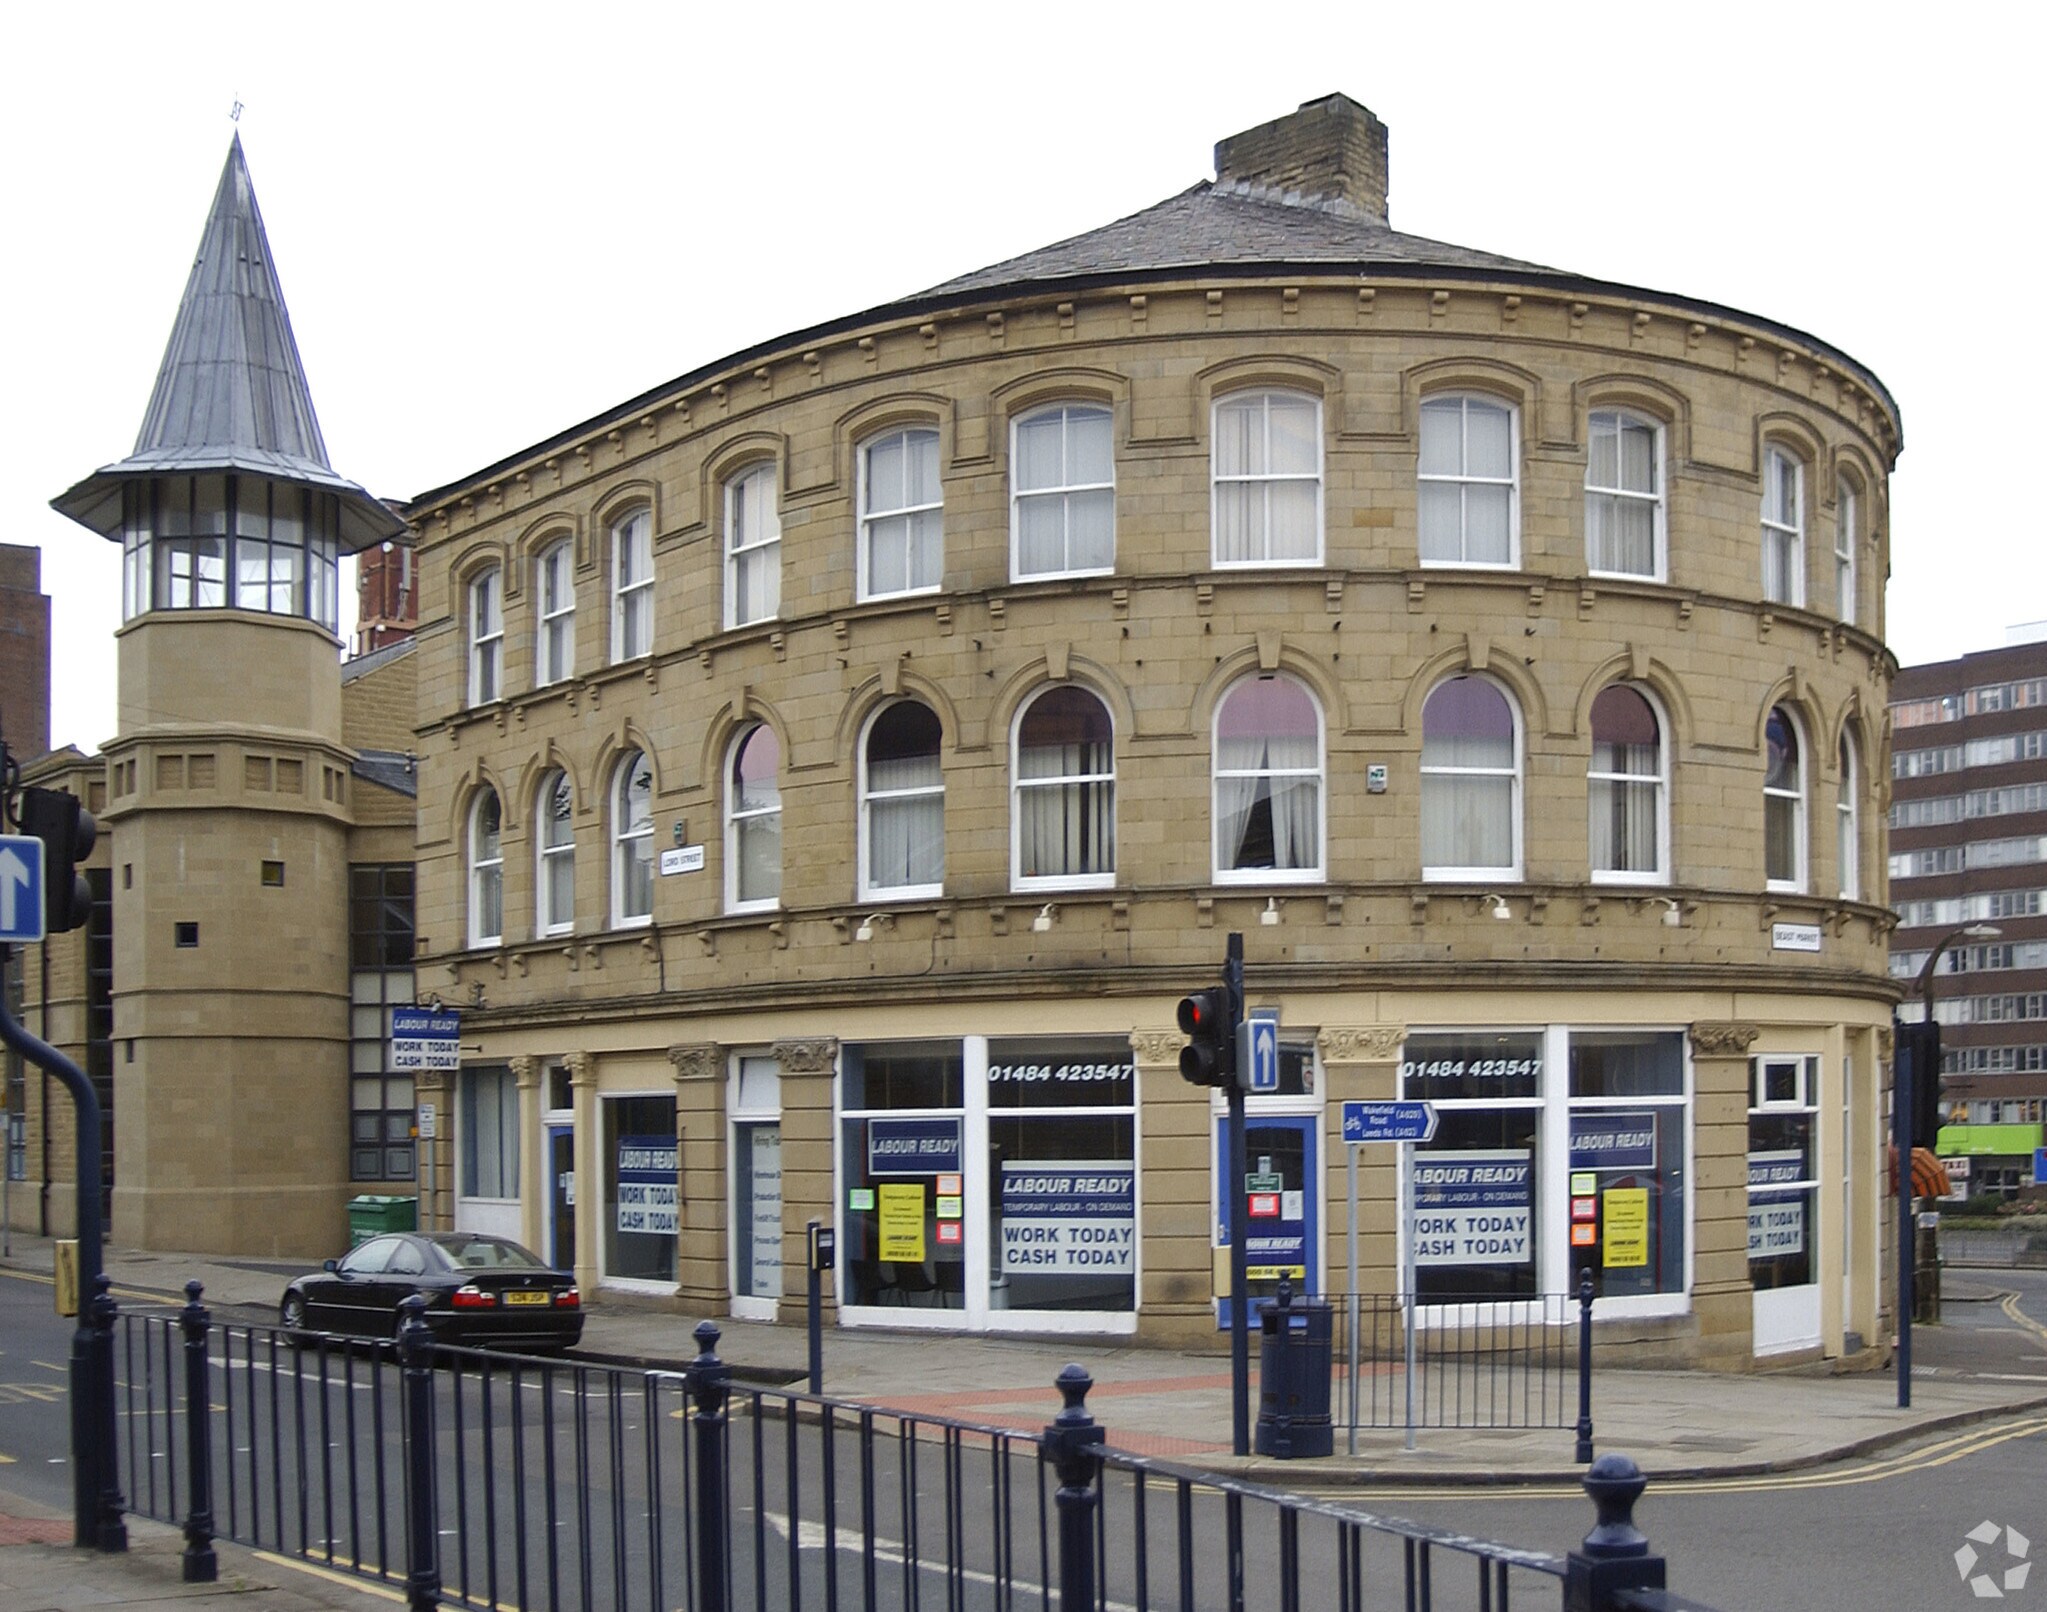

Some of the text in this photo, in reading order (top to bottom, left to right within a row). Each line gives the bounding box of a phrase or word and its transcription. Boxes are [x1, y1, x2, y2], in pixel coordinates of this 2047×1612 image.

[664, 853, 701, 867] LORD STREET
[394, 1018, 459, 1030] LABOUR READY
[395, 1042, 459, 1052] WORK TODAY
[395, 1056, 457, 1067] CASH TODAY
[1402, 1059, 1543, 1077] 01484 423547
[989, 1064, 1134, 1081] 01484 423547
[1369, 1115, 1388, 1125] Road
[872, 1138, 959, 1154] LABOUR READY
[1569, 1132, 1652, 1150] LABOUR READY
[619, 1150, 650, 1169] LABOUR
[1413, 1167, 1528, 1184] ABOUR READY
[1770, 1166, 1801, 1181] READY
[1003, 1178, 1132, 1194] LABOUR READY
[619, 1187, 645, 1204] WORK
[1448, 1192, 1479, 1202] LABOUR
[1496, 1191, 1529, 1201] DEMAND
[1003, 1202, 1048, 1212] TEMPORARY
[1050, 1202, 1080, 1212] LABOUR
[1099, 1202, 1132, 1211] DEMAND
[621, 1211, 644, 1229] CASH
[1465, 1217, 1527, 1233] TODAY
[1767, 1211, 1800, 1227] TODAY
[1004, 1227, 1132, 1244] WORK TODAY
[1271, 1237, 1302, 1249] READY
[1766, 1231, 1799, 1247] TODAY
[1464, 1238, 1525, 1255] TODAY
[1007, 1249, 1130, 1265] CASH TODAY
